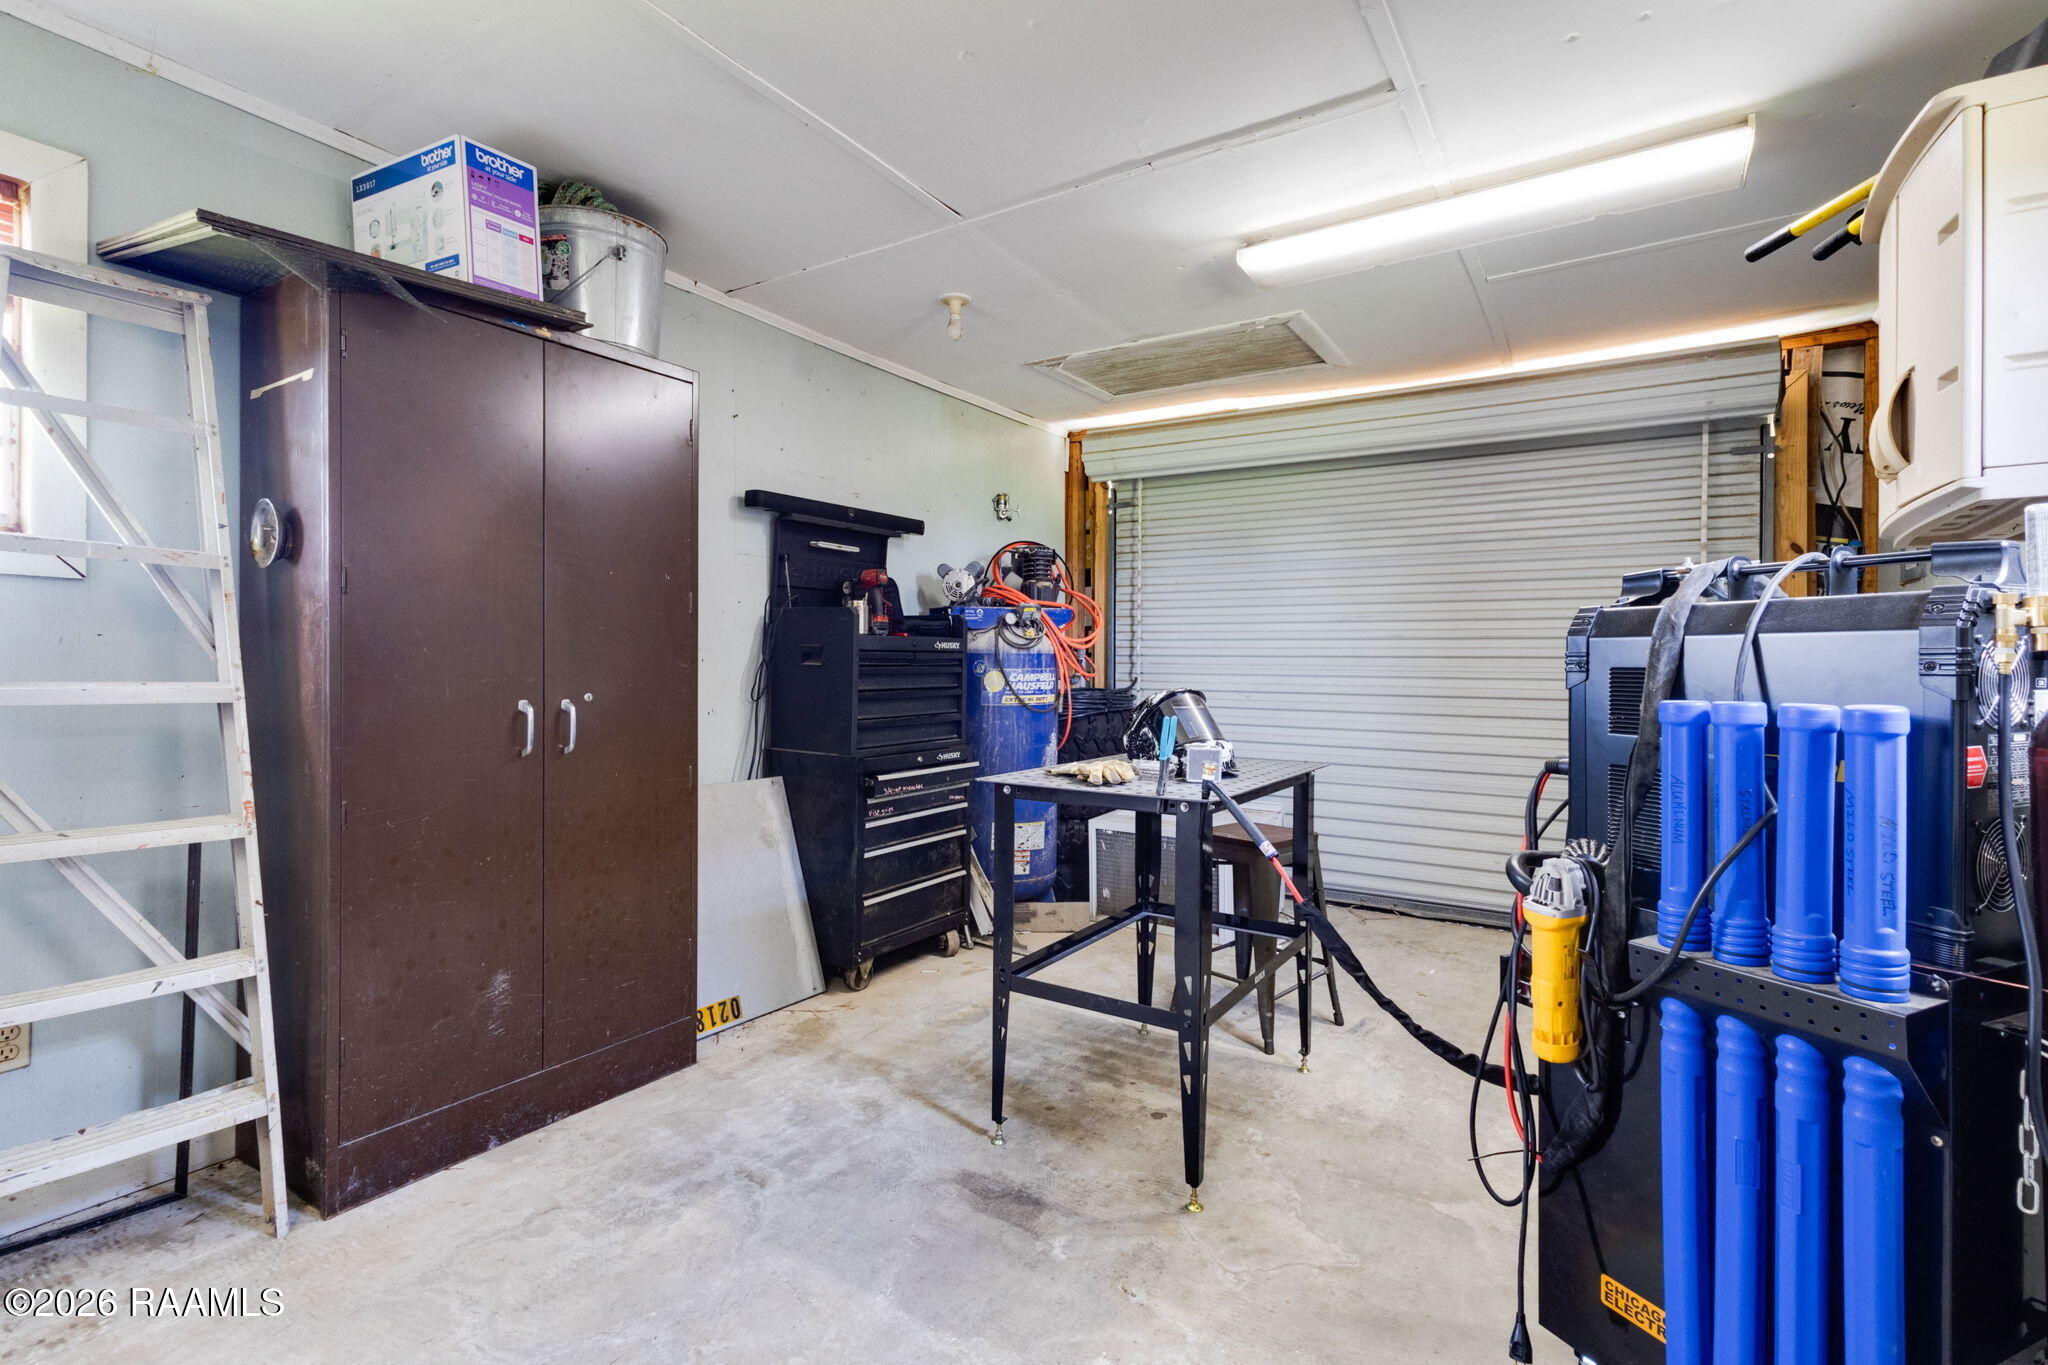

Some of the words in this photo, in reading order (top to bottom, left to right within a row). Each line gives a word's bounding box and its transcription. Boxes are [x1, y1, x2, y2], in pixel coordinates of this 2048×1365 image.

[421, 145, 453, 167] brother
[475, 147, 525, 179] brother
[492, 169, 505, 178] your
[505, 174, 517, 183] side
[941, 641, 960, 650] HUSKY
[1009, 672, 1056, 682] CAMPBELL
[943, 751, 961, 760] HUSKY
[1670, 774, 1687, 844] ALUMINUM
[1879, 871, 1897, 917] STEEL
